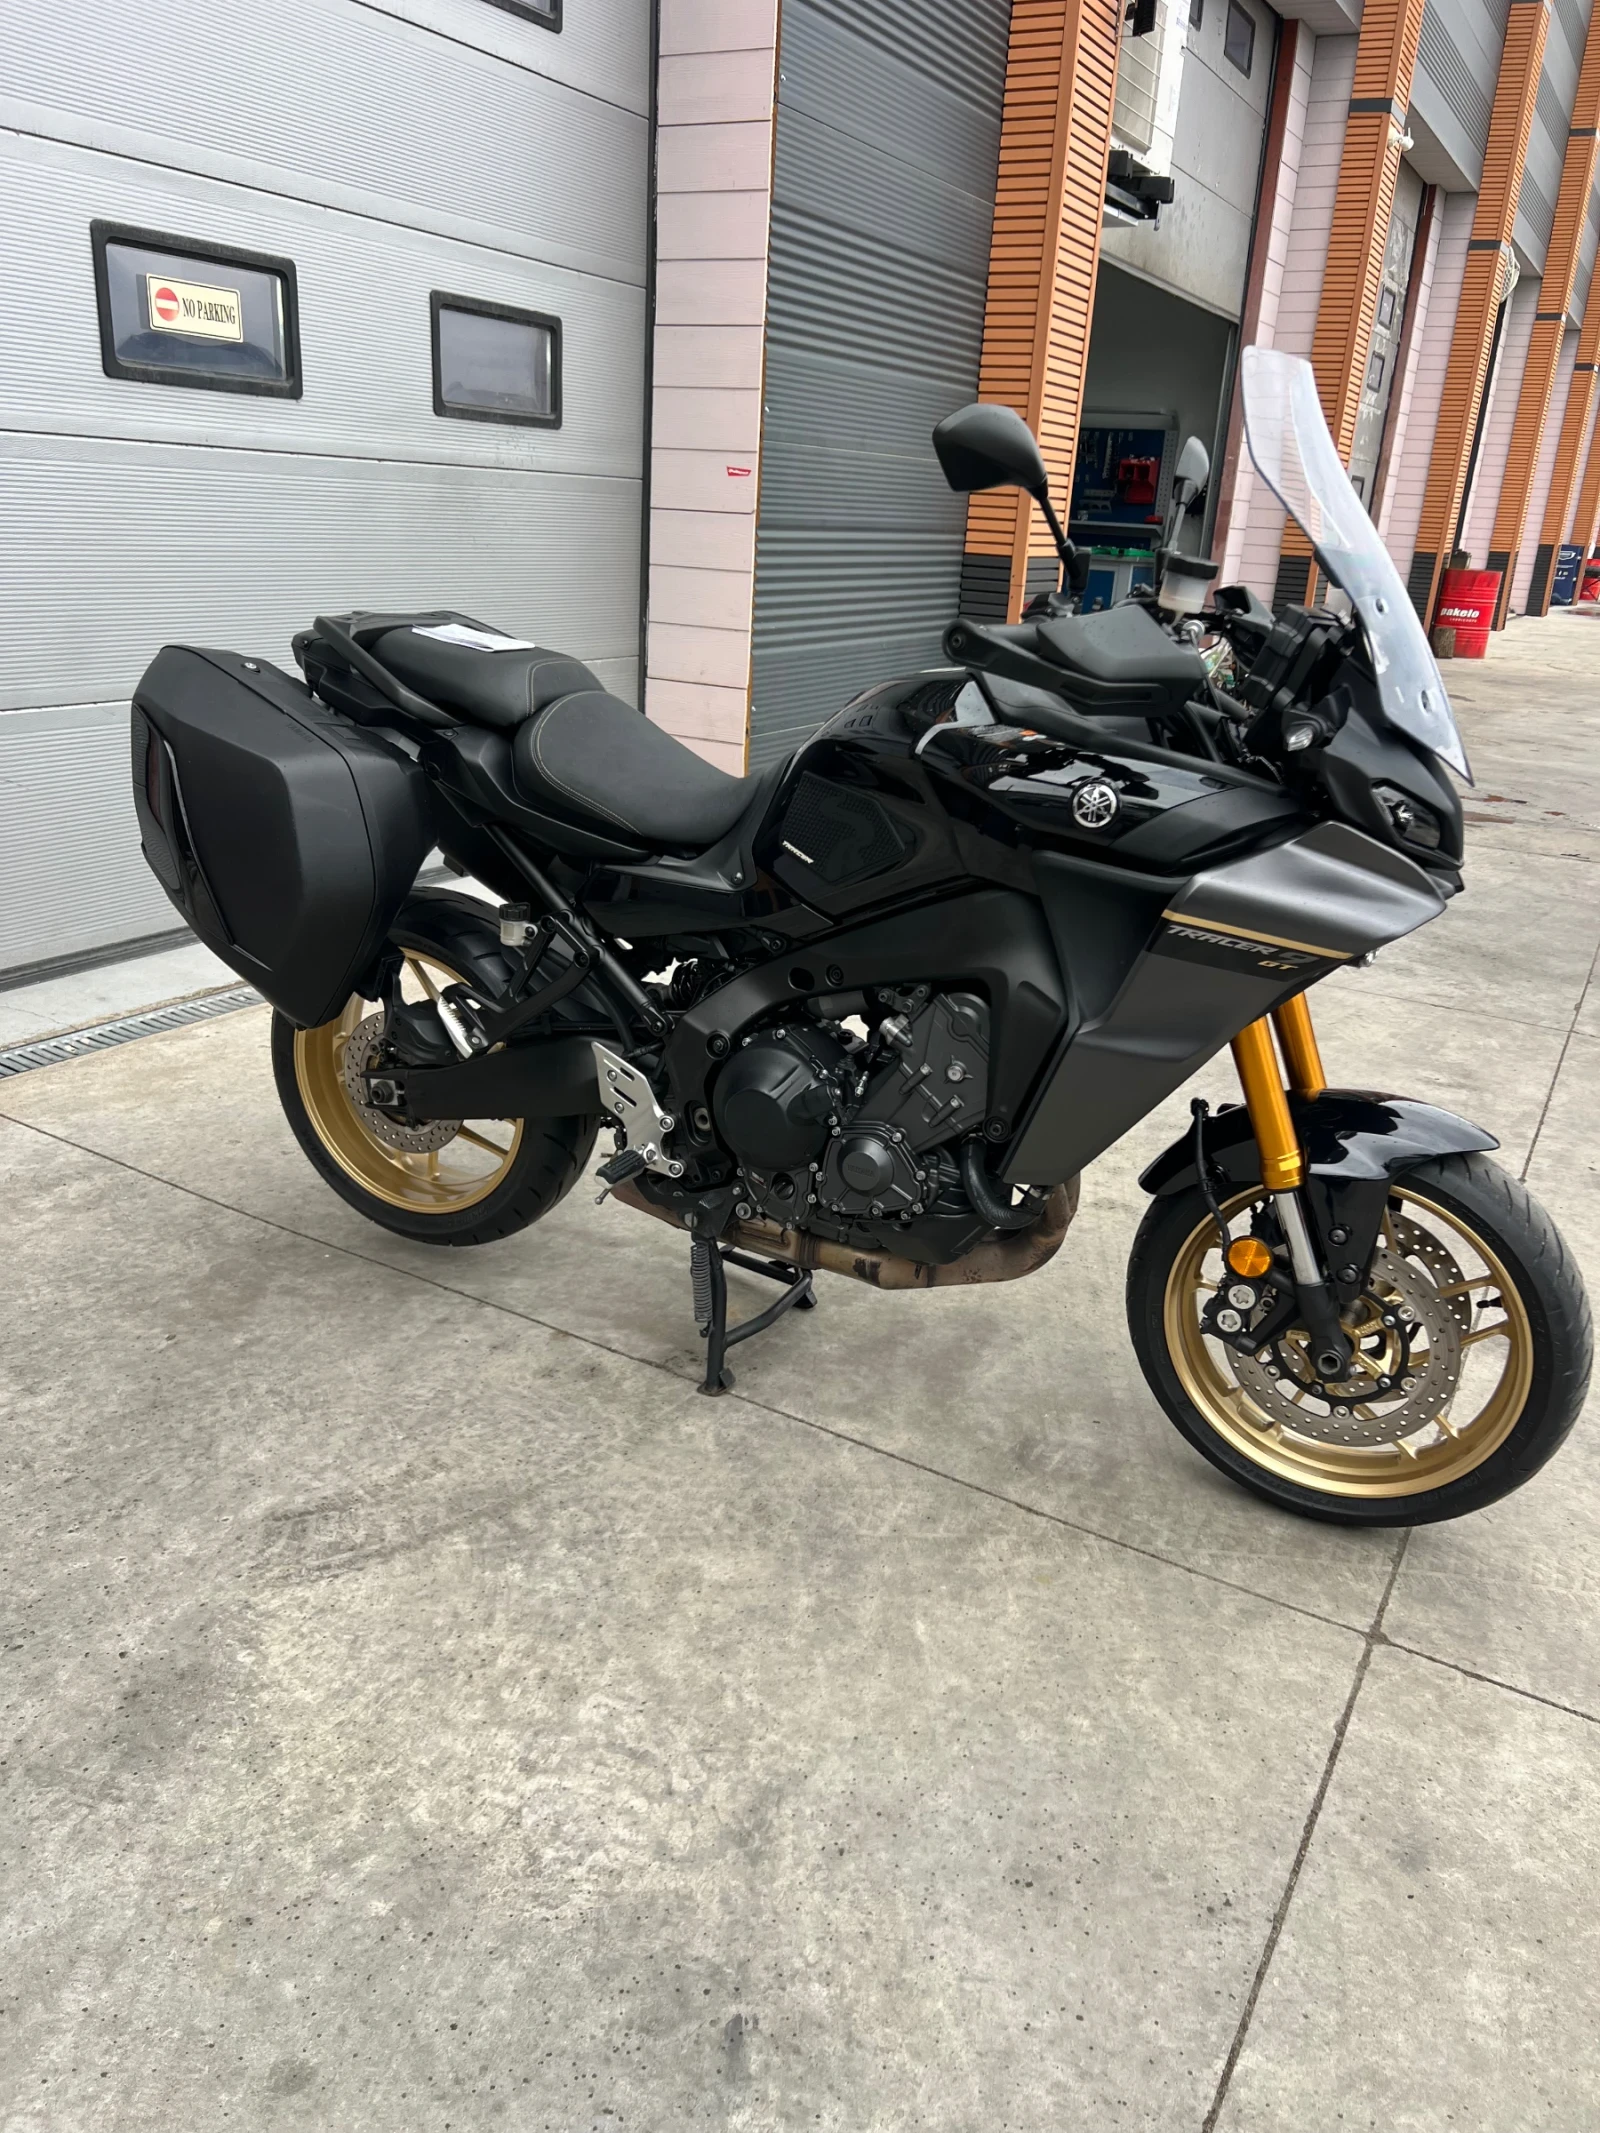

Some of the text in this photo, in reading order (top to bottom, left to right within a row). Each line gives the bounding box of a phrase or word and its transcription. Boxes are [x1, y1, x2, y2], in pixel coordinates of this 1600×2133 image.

[182, 297, 236, 325] NO PARKING
[1440, 607, 1480, 618] pakelo
[1167, 924, 1321, 964] TRACER 9
[1257, 960, 1299, 970] GT
